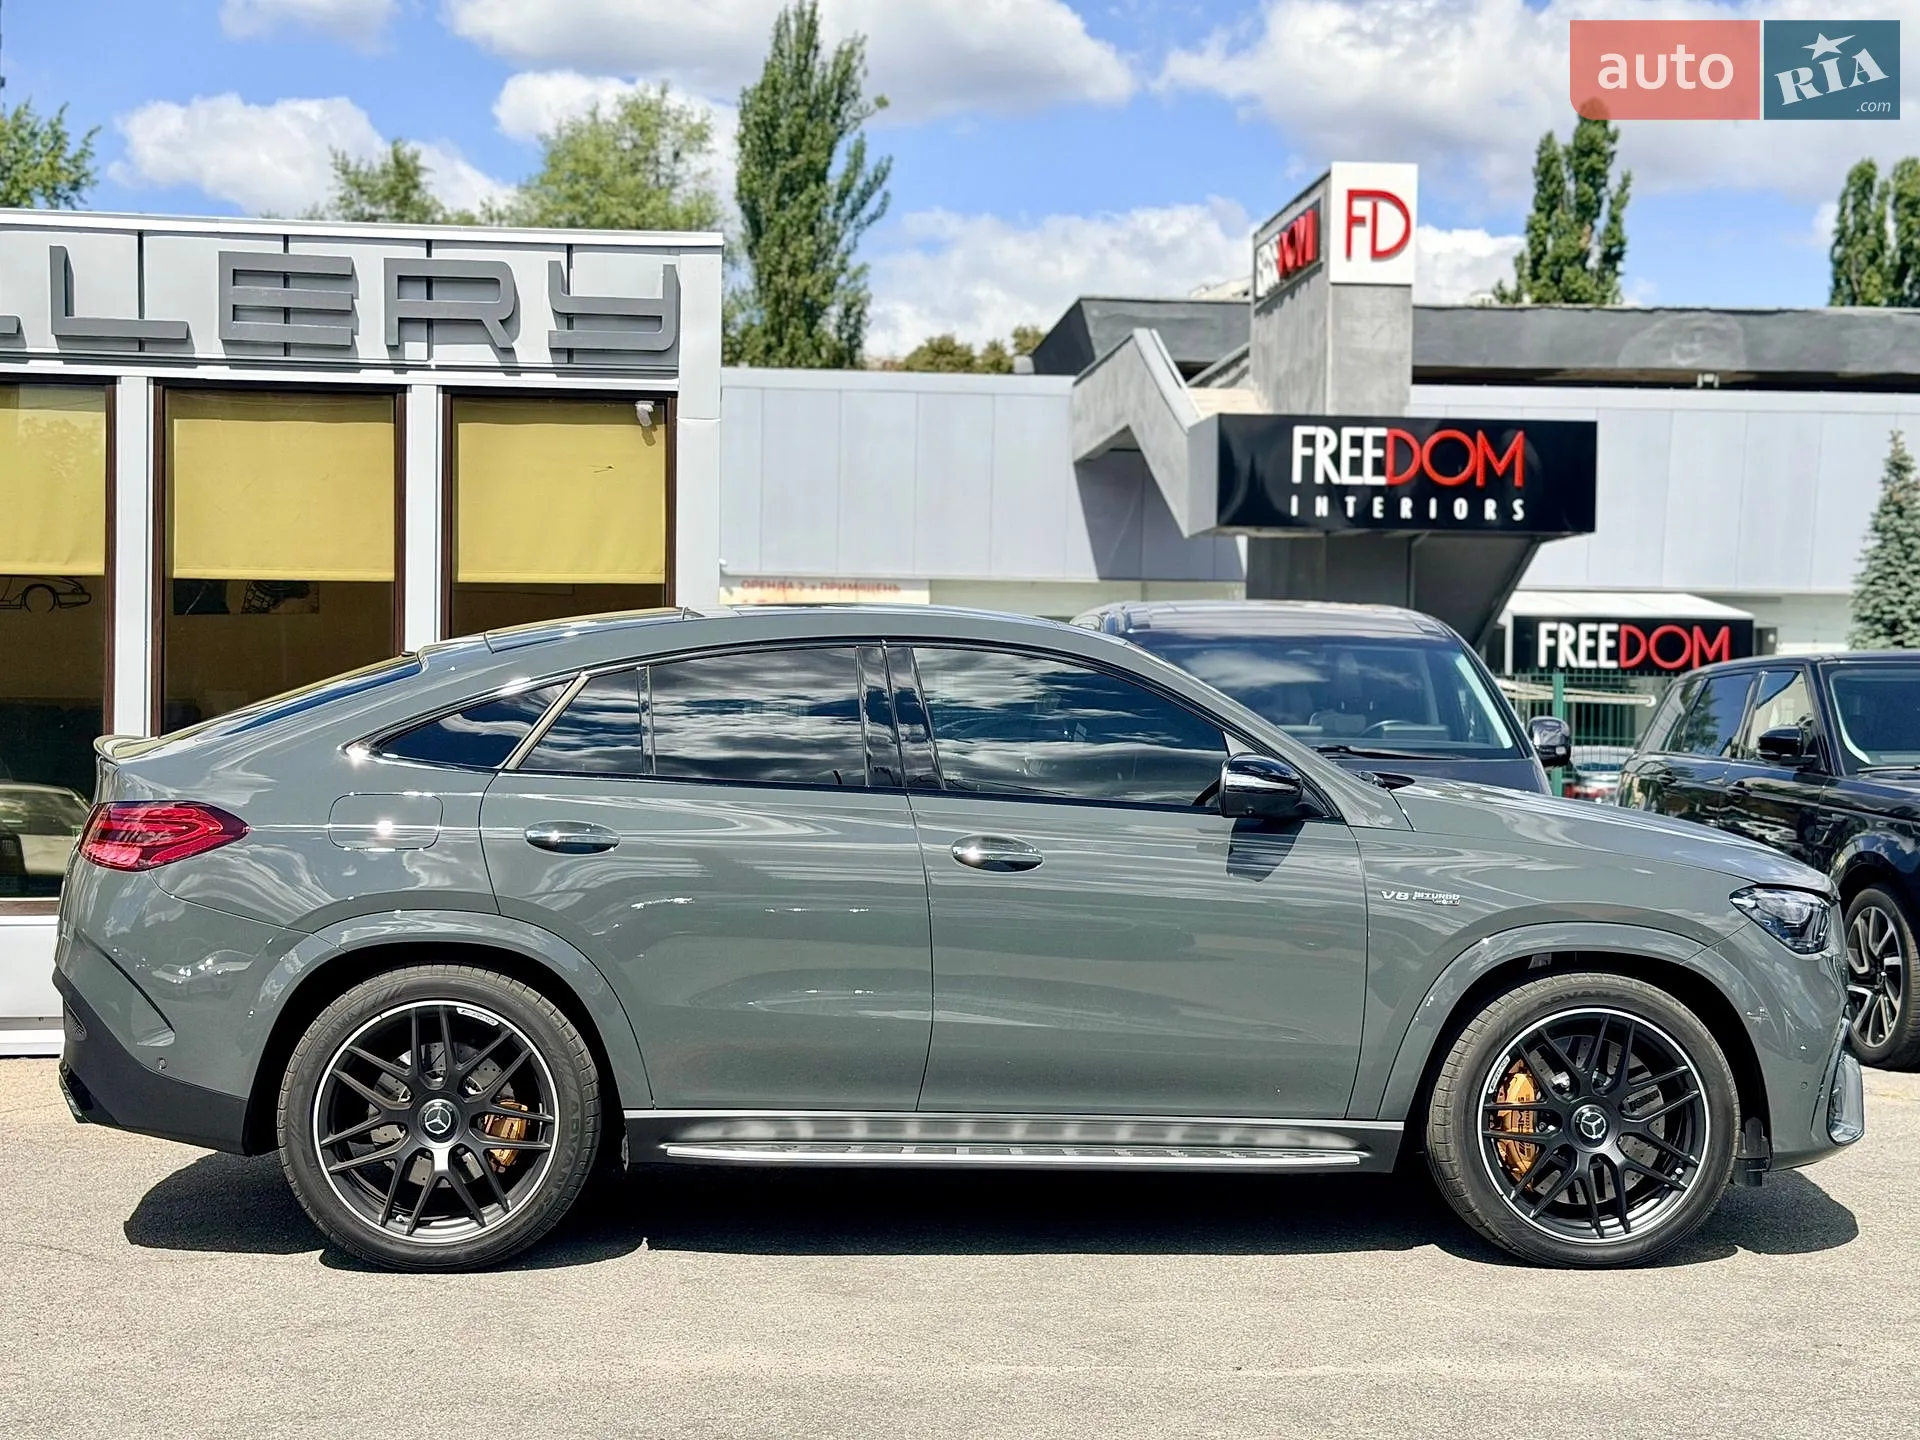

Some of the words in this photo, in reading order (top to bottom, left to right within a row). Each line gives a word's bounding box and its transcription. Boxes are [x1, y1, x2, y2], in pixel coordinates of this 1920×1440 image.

[1346, 189, 1412, 262] FD
[0, 244, 682, 353] LERY
[1291, 425, 1526, 488] FREEDOM
[1290, 494, 1526, 521] INTERIORS
[1537, 621, 1731, 671] FREEDOM
